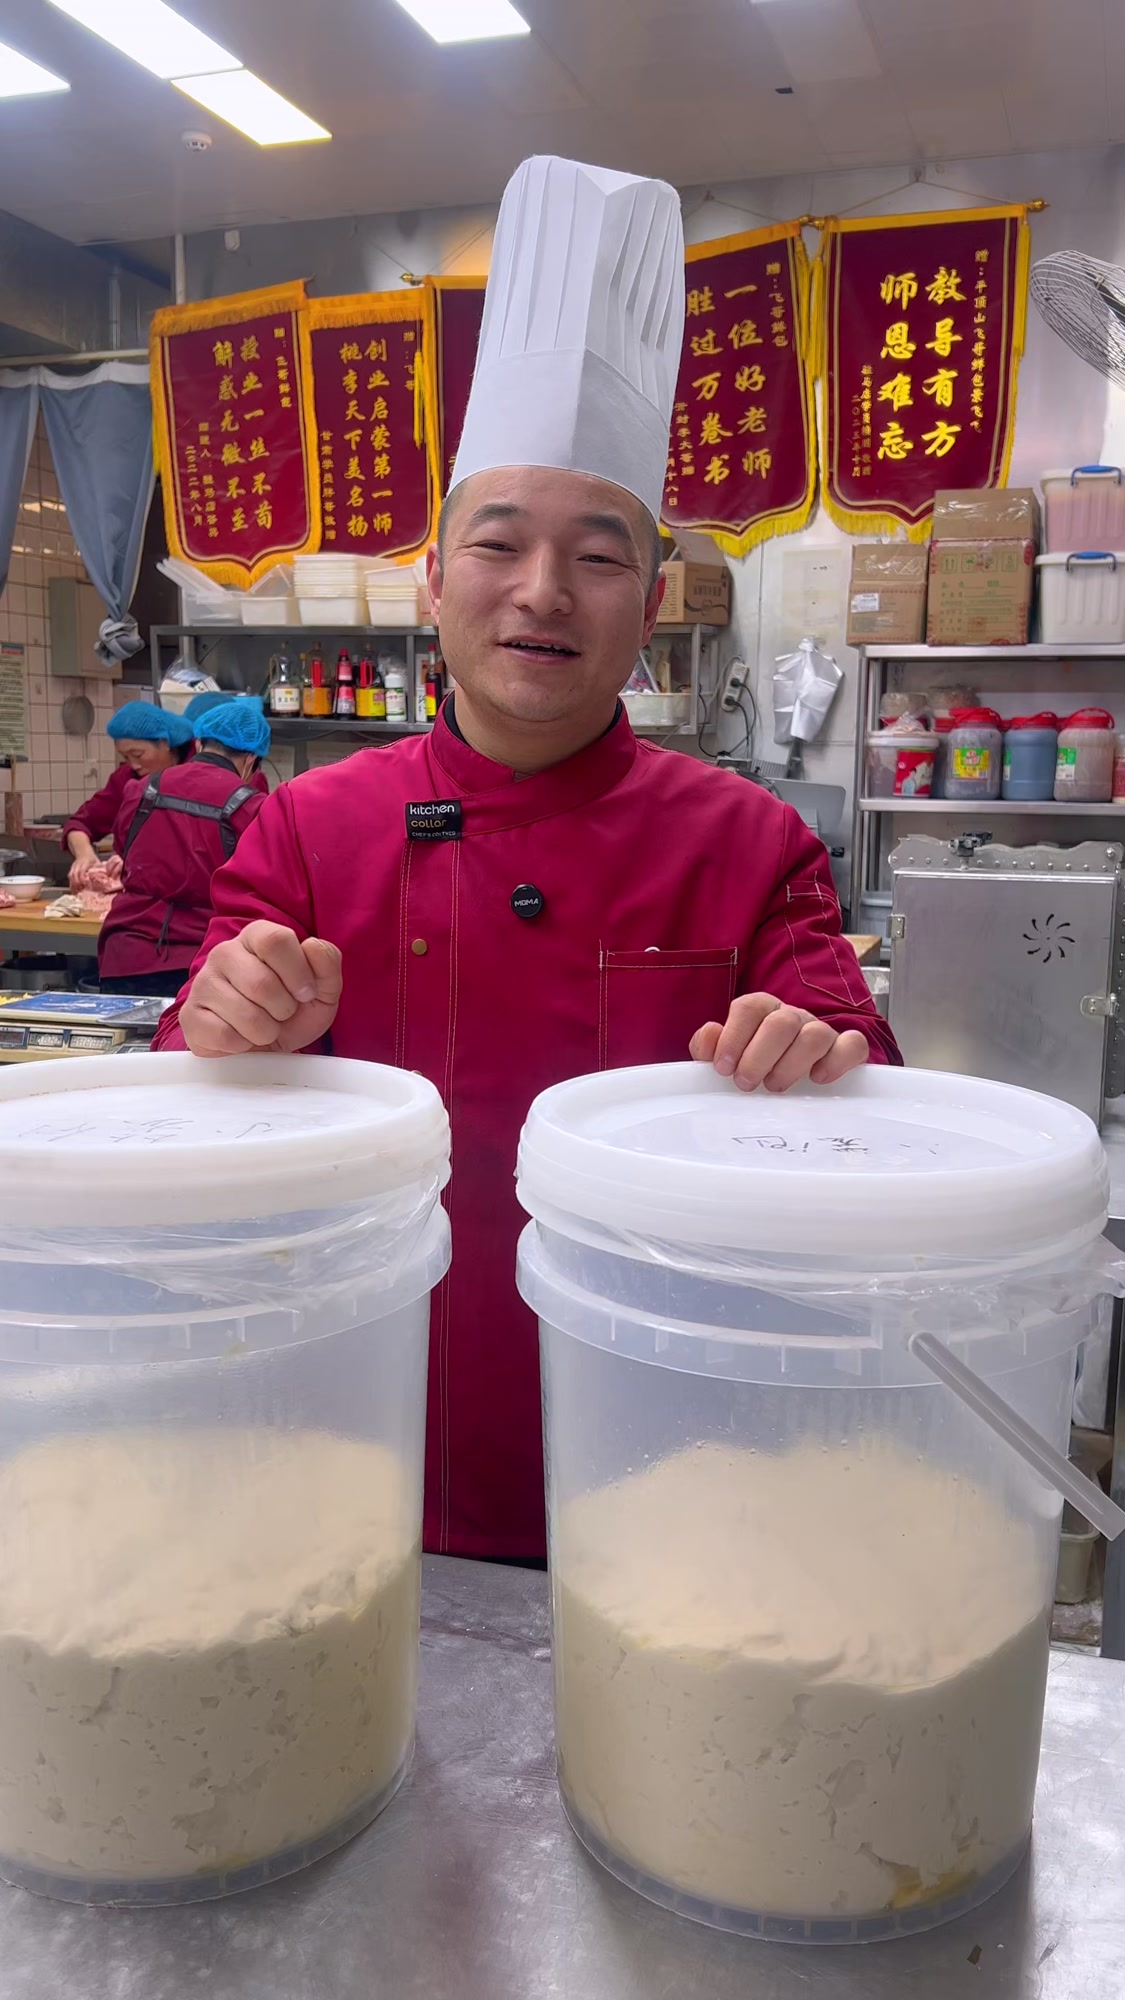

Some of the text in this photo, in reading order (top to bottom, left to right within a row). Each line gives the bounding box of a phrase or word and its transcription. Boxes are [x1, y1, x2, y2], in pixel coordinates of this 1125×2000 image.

[212, 340, 249, 533] 解惑无微不至
[239, 335, 273, 530] 授业一丝不苟
[339, 342, 368, 537] 桃李天下美名扬
[364, 338, 393, 535] 创业启蒙第一师
[686, 286, 733, 485] 胜过万卷书
[724, 284, 772, 479] 一位好老师
[877, 271, 918, 460] 师恩难忘
[921, 266, 967, 458] 教导有方
[409, 803, 455, 816] kitchen
[410, 819, 447, 828] collar
